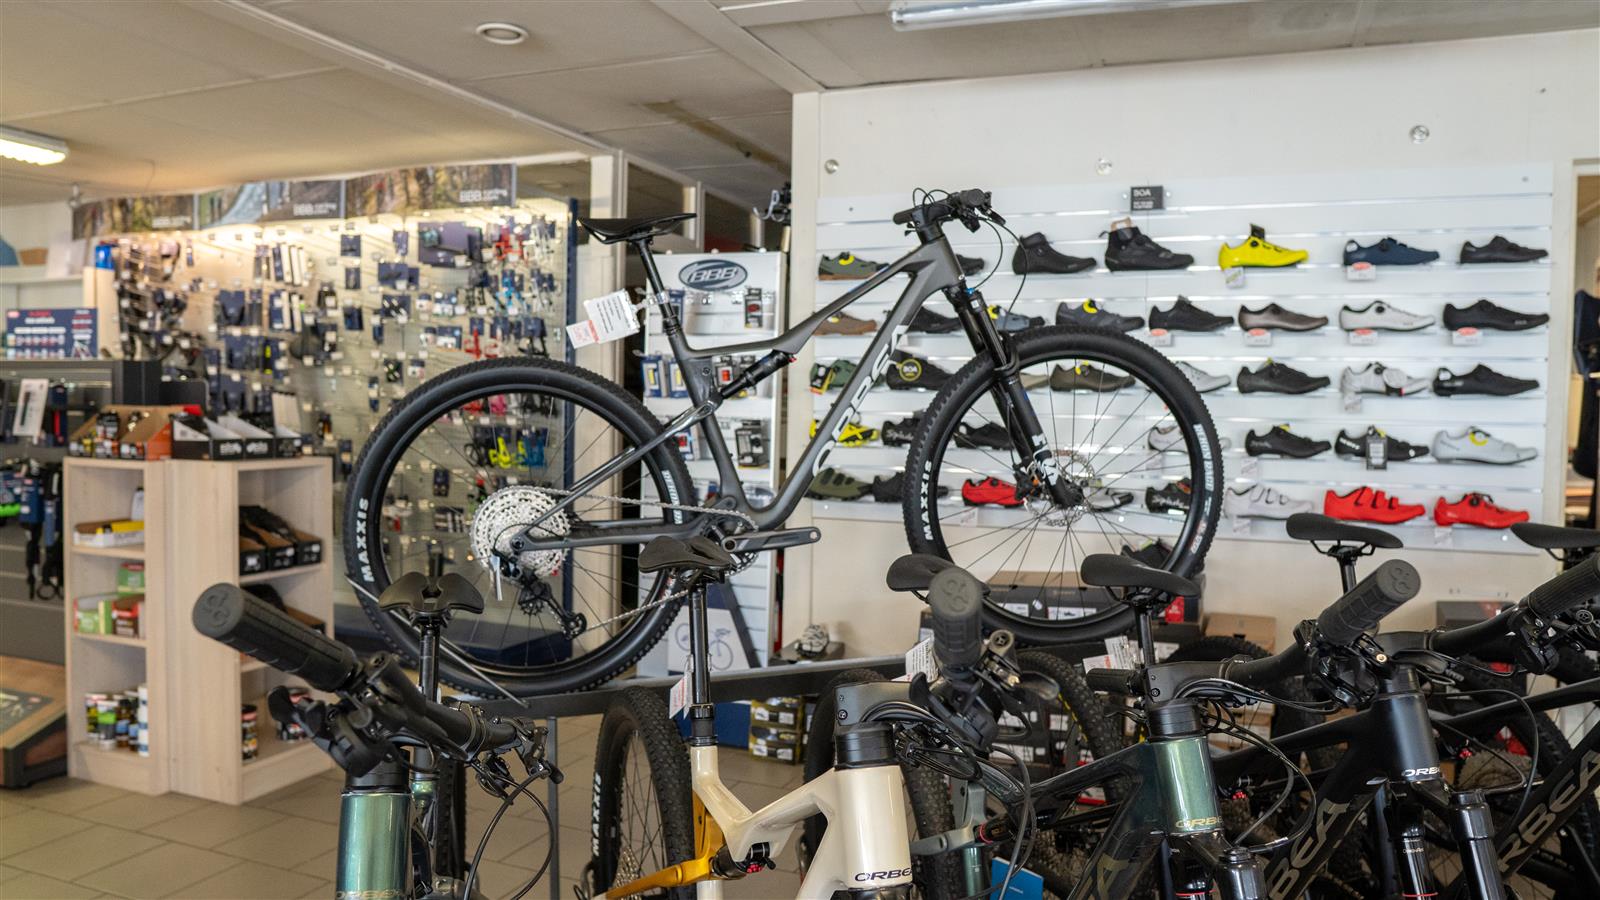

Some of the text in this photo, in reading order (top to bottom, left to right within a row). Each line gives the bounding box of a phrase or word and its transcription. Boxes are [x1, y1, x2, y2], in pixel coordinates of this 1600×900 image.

[688, 267, 737, 283] BBB
[356, 497, 375, 582] MAXXIS
[920, 460, 934, 541] MAXXIS
[1401, 766, 1441, 777] ORB
[1496, 750, 1600, 873] RBEA
[592, 771, 601, 857] MAXXIS
[1175, 815, 1223, 829] ORB
[1262, 798, 1351, 900] BEA
[854, 867, 913, 882] ORBE
